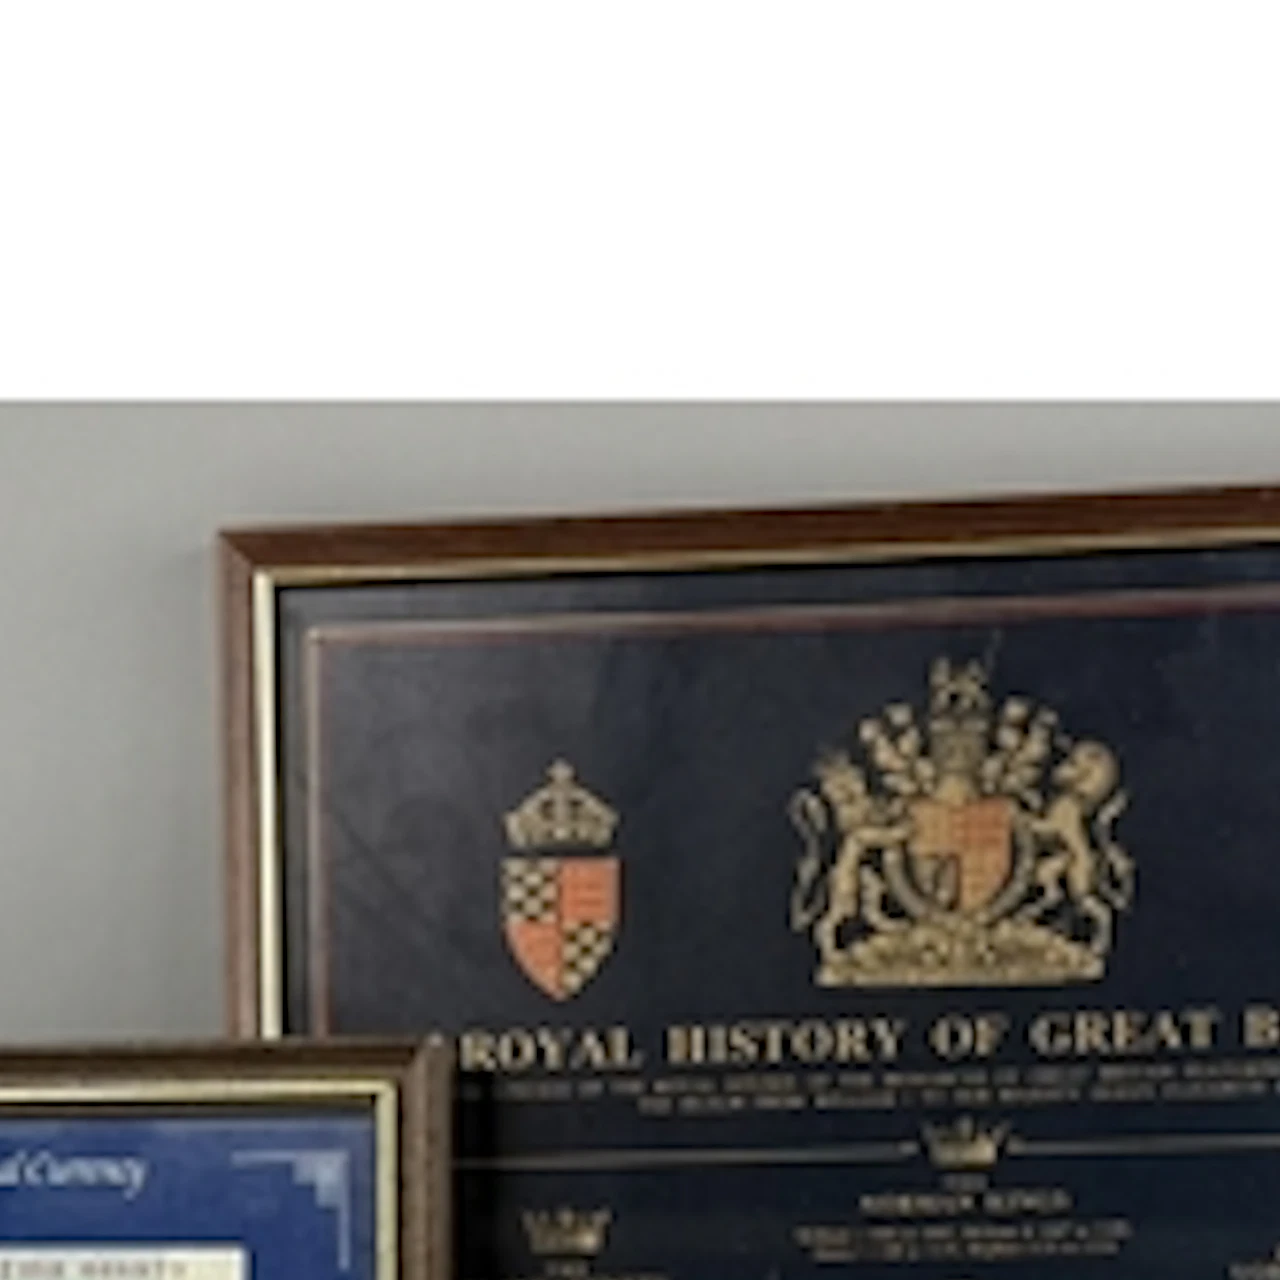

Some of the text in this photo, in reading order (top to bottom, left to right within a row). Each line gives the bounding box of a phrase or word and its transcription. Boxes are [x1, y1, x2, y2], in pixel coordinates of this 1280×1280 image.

[459, 1025, 646, 1073] ROYAL
[666, 1014, 904, 1066] HISTORY
[928, 1011, 1007, 1062] OF
[1028, 1006, 1220, 1057] GREAT
